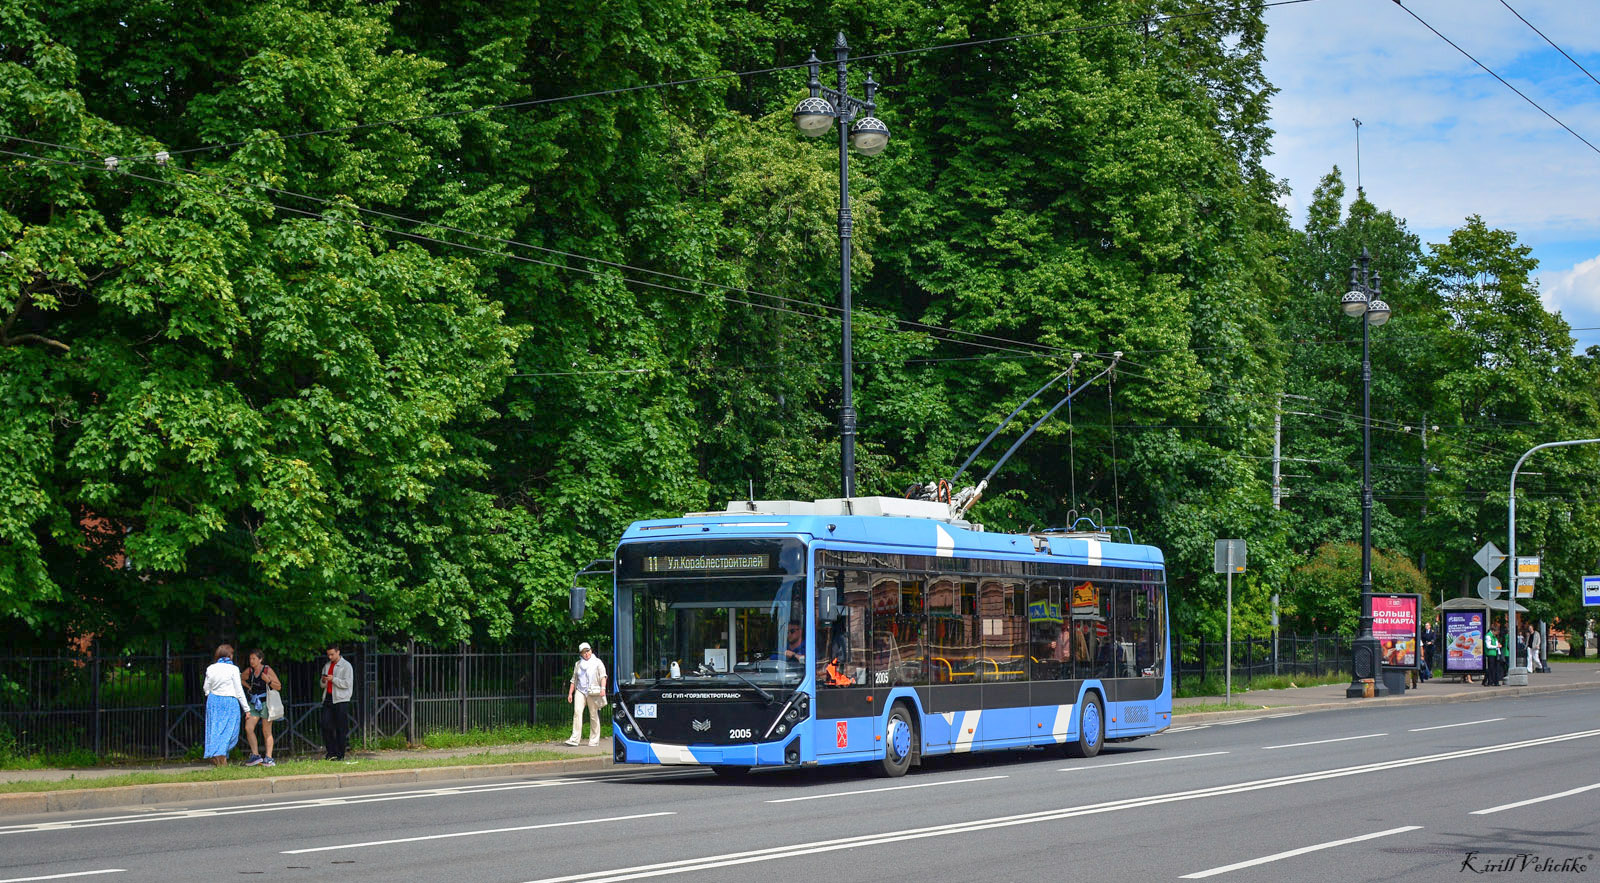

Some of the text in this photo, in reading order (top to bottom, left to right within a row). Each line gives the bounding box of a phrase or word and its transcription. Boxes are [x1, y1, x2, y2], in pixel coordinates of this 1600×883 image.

[648, 557, 658, 571] 11
[1373, 610, 1414, 618] БОЛЬШЕ,
[875, 672, 889, 684] 2005
[729, 728, 752, 739] 2005
